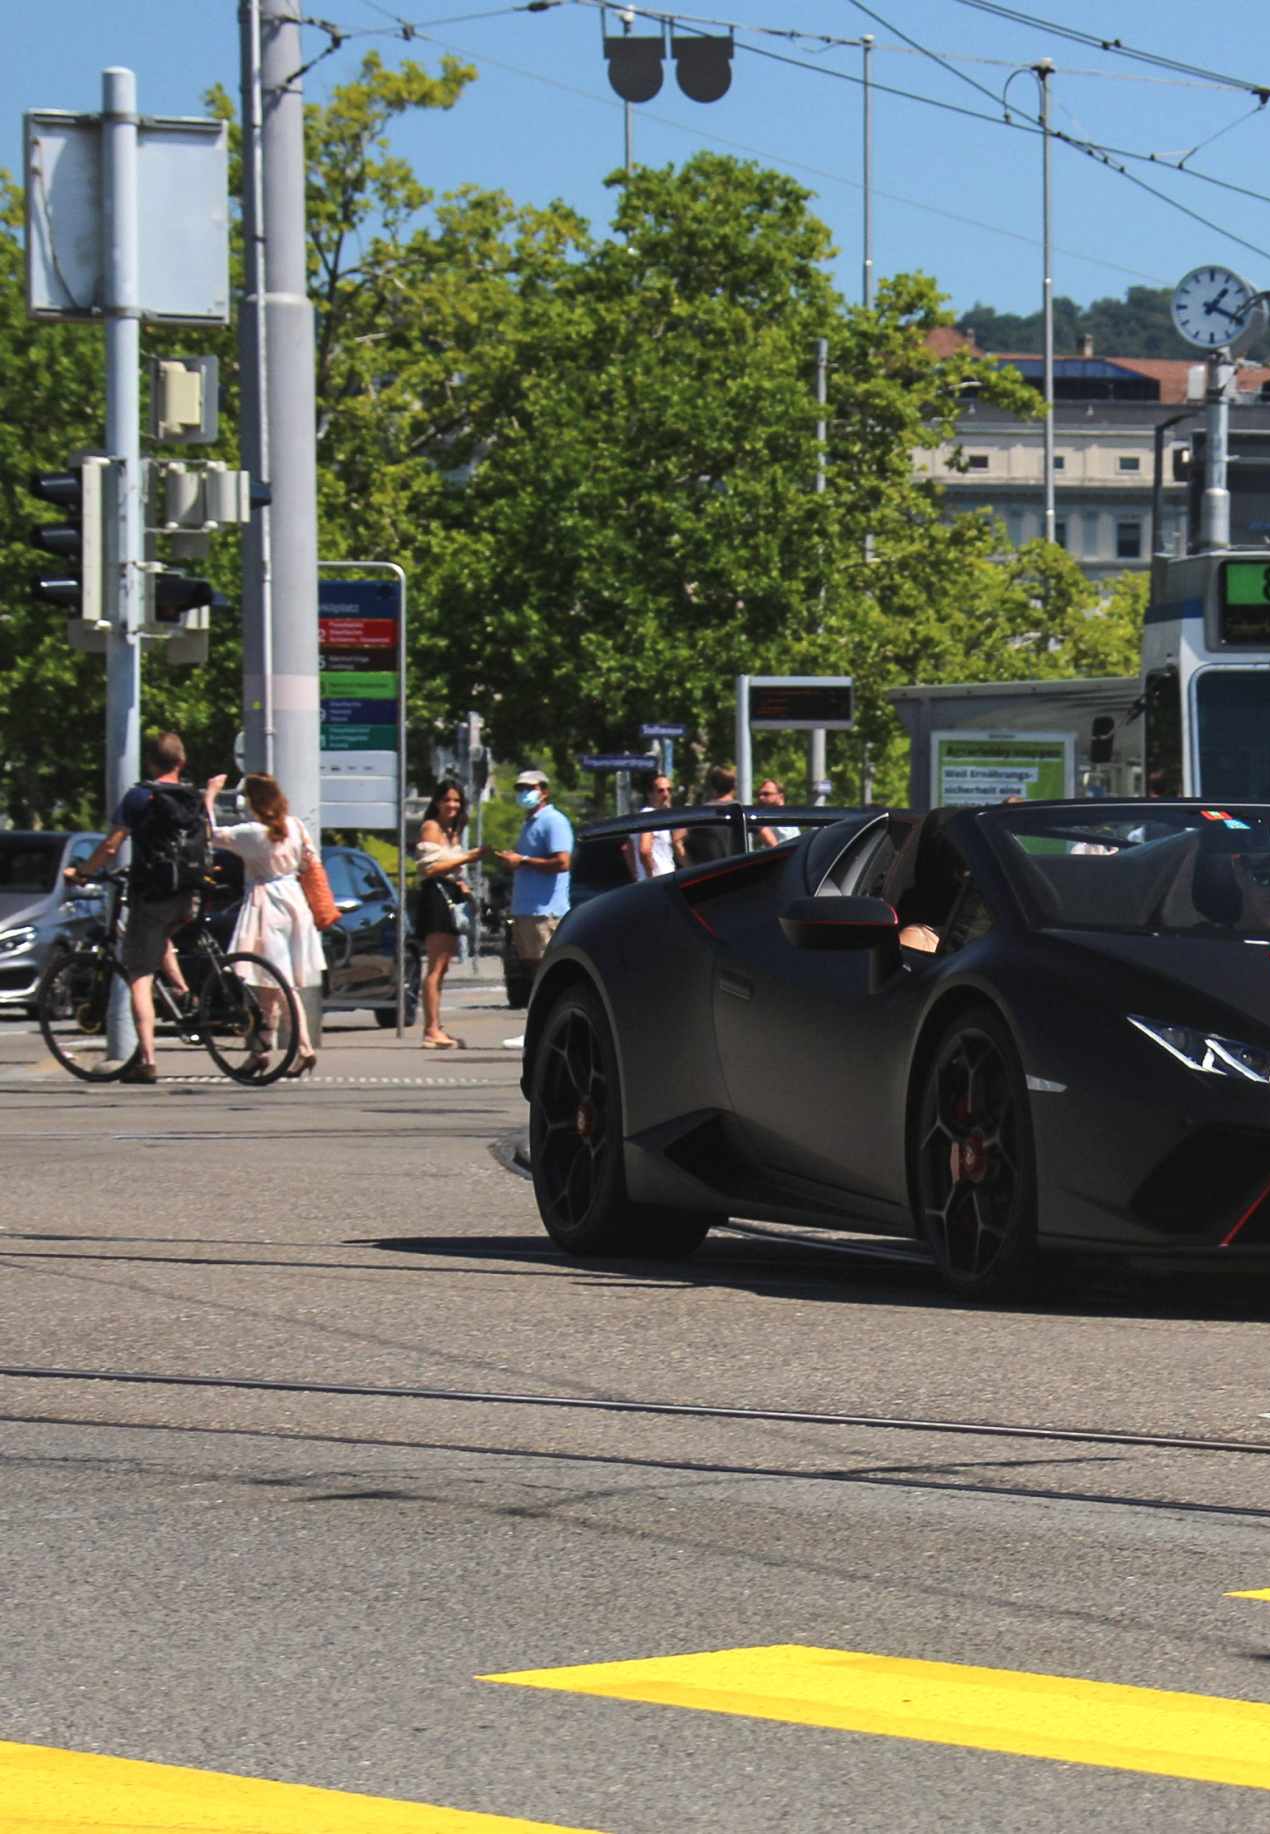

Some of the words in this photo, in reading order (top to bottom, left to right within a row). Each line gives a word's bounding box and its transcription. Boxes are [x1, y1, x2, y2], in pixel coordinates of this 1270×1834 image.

[944, 768, 967, 778] Weil
[969, 767, 1035, 782] Ernährungs-
[944, 784, 997, 794] sicherheit
[999, 786, 1022, 795] eine
